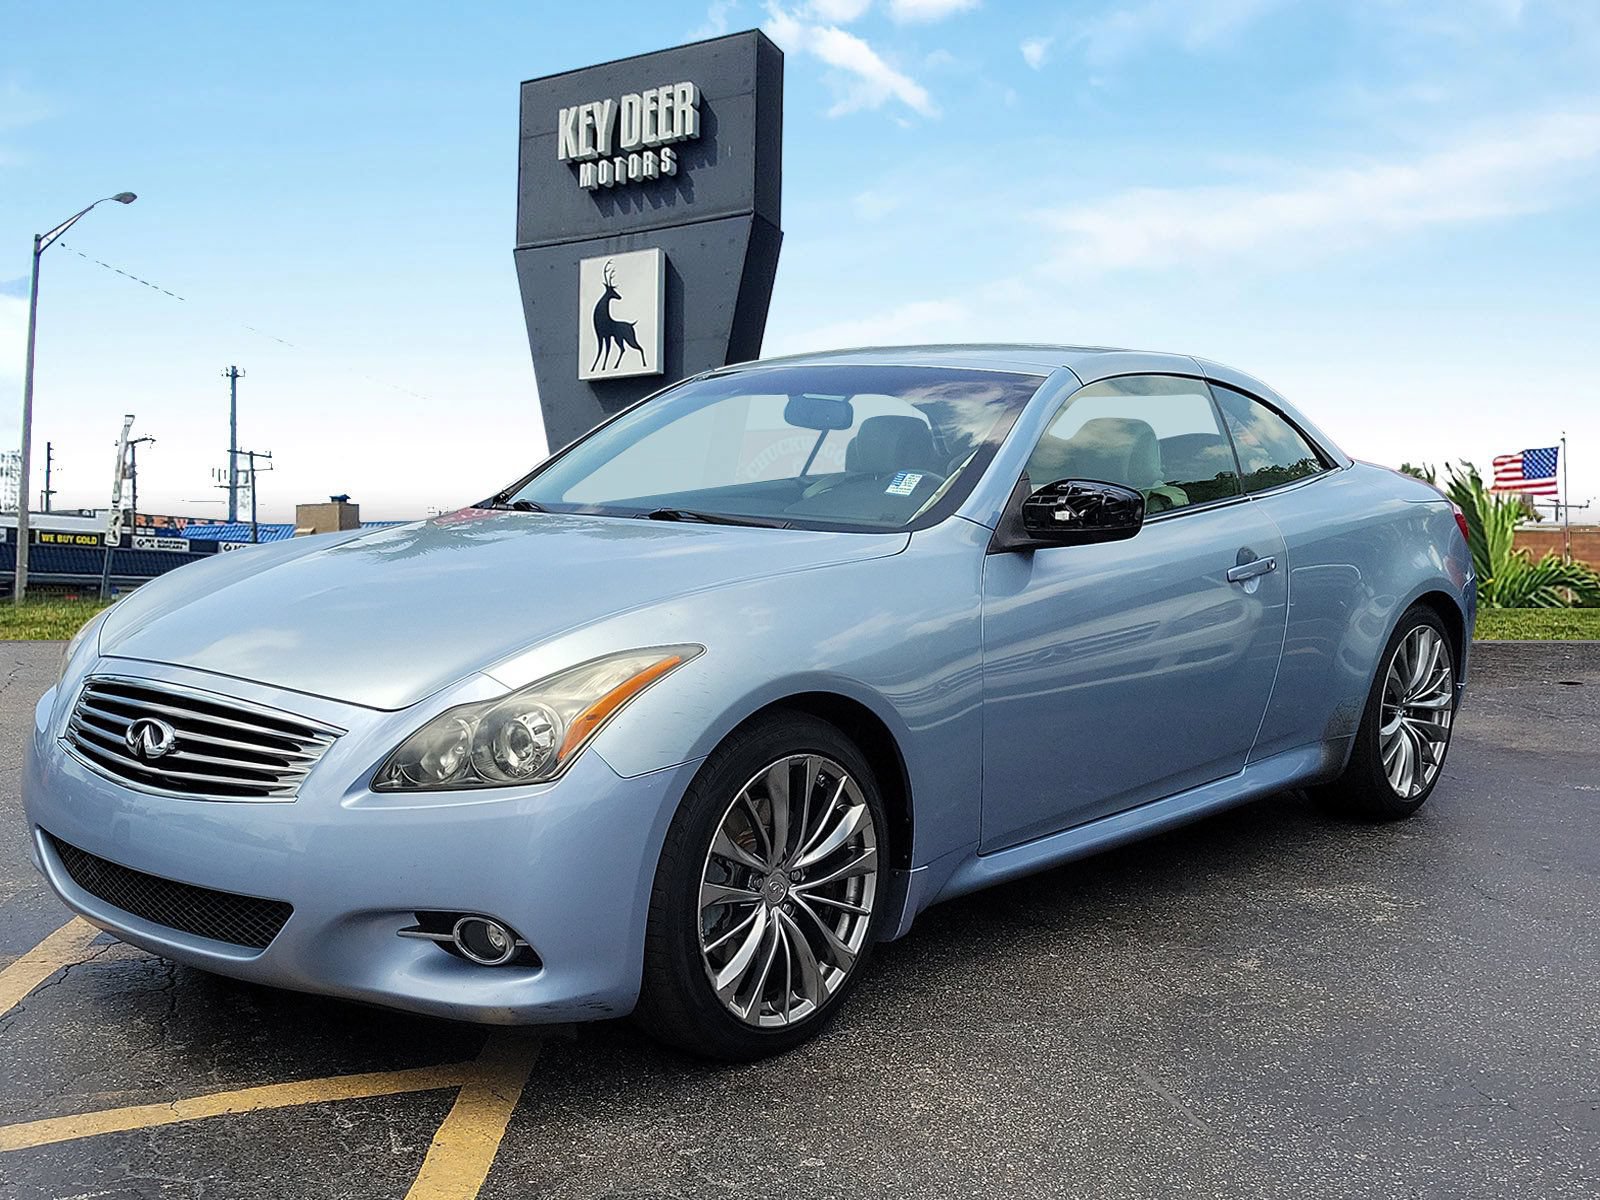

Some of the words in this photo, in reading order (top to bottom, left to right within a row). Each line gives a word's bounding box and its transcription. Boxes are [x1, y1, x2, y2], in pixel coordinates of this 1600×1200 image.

[558, 99, 617, 163] KEY
[620, 81, 700, 151] DEER
[579, 147, 677, 189] MOTORS
[41, 533, 55, 542] WE
[57, 534, 74, 544] BUY
[76, 535, 97, 545] GOLD
